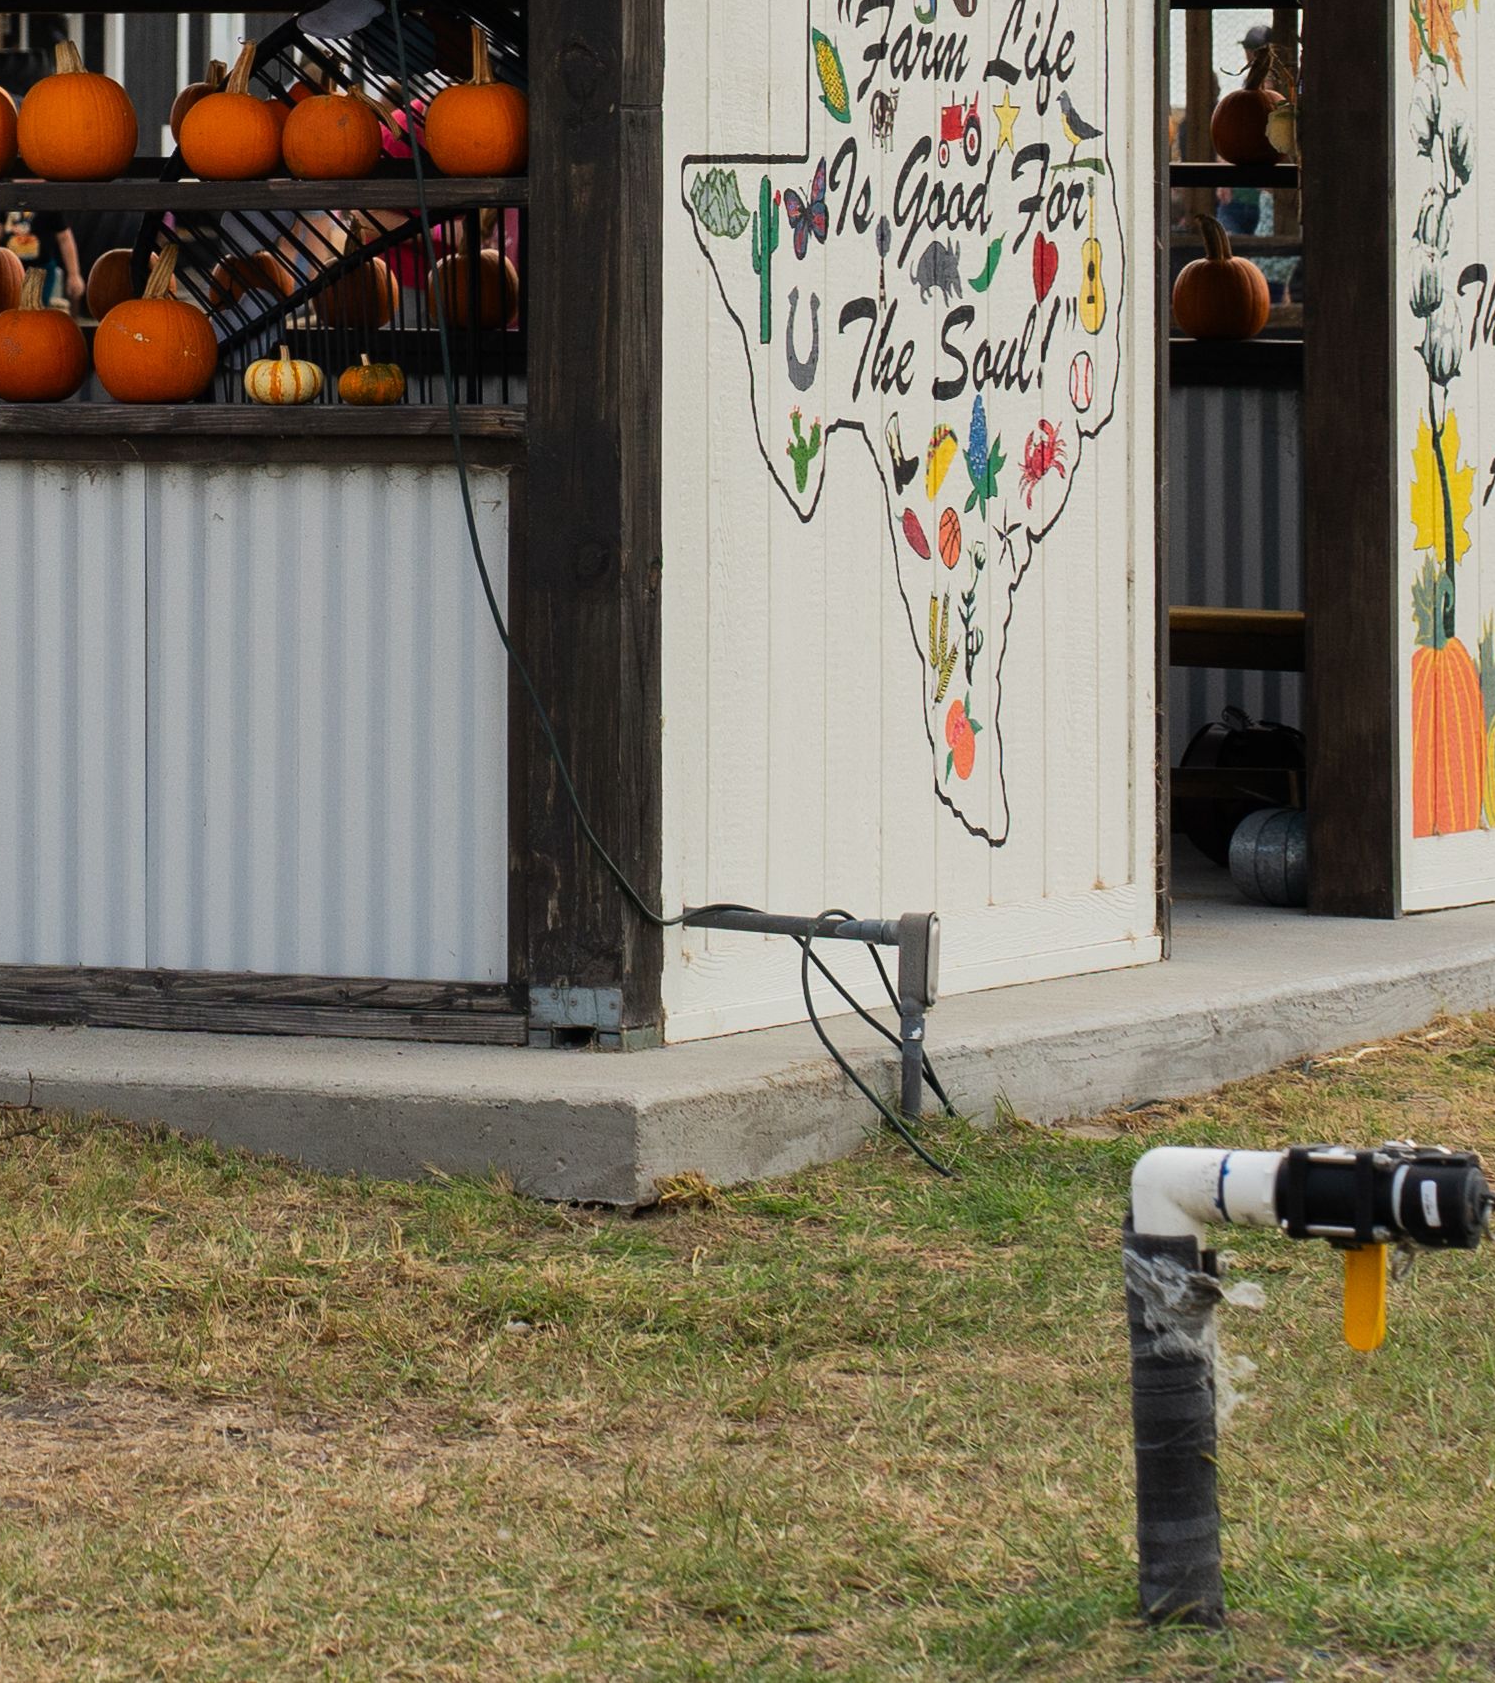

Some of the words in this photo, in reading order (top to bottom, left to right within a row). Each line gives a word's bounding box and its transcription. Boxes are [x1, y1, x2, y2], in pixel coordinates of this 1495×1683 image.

[828, 135, 875, 237] Is
[893, 134, 997, 270] Good
[1011, 142, 1088, 255] For
[838, 295, 916, 403] The
